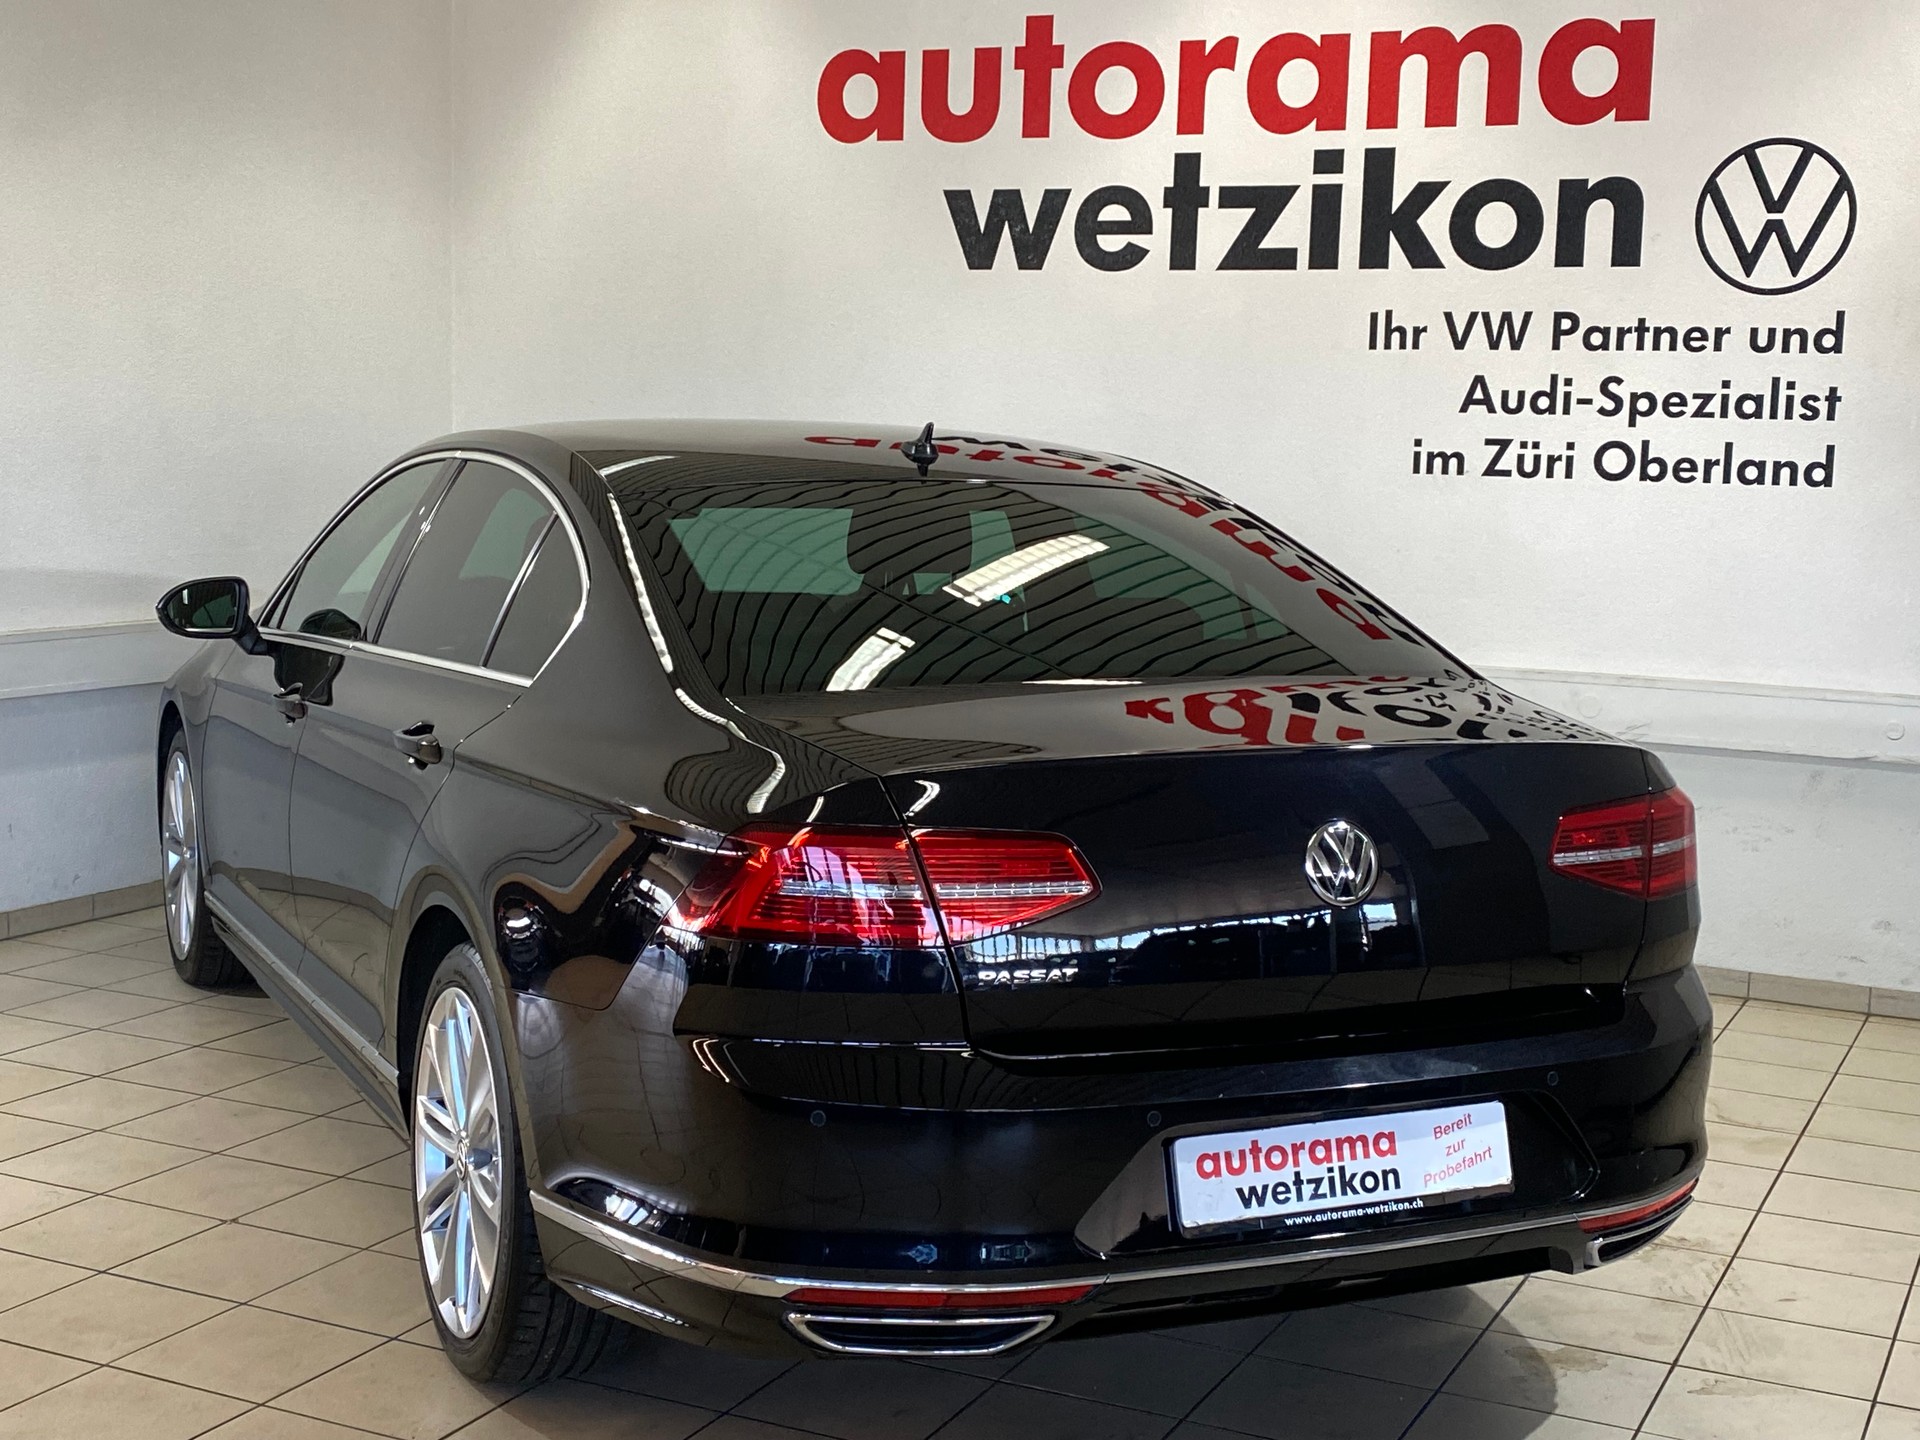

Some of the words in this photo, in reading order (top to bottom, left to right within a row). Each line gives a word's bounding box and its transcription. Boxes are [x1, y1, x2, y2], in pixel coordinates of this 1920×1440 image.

[816, 14, 1655, 144] autorama
[943, 147, 1644, 272] wetzikon
[1695, 137, 1857, 296] VW
[1368, 309, 1428, 351] Ihr
[1443, 310, 1534, 352] VW
[1551, 310, 1732, 353] Partner
[1749, 310, 1846, 355] und
[1458, 373, 1842, 428] Audi-Spezialist
[1412, 438, 1465, 477] im
[1481, 438, 1575, 480] Züri
[1593, 439, 1836, 488] Oberland
[978, 967, 1079, 985] PASSAT
[1432, 1112, 1473, 1140] Bereit
[1445, 1136, 1467, 1157] zur
[1195, 1130, 1398, 1180] autorama
[1422, 1146, 1494, 1189] Probefahrt
[1235, 1164, 1401, 1209] wetzikon
[1284, 1197, 1424, 1226] www.autorama-wetzikon.ch
